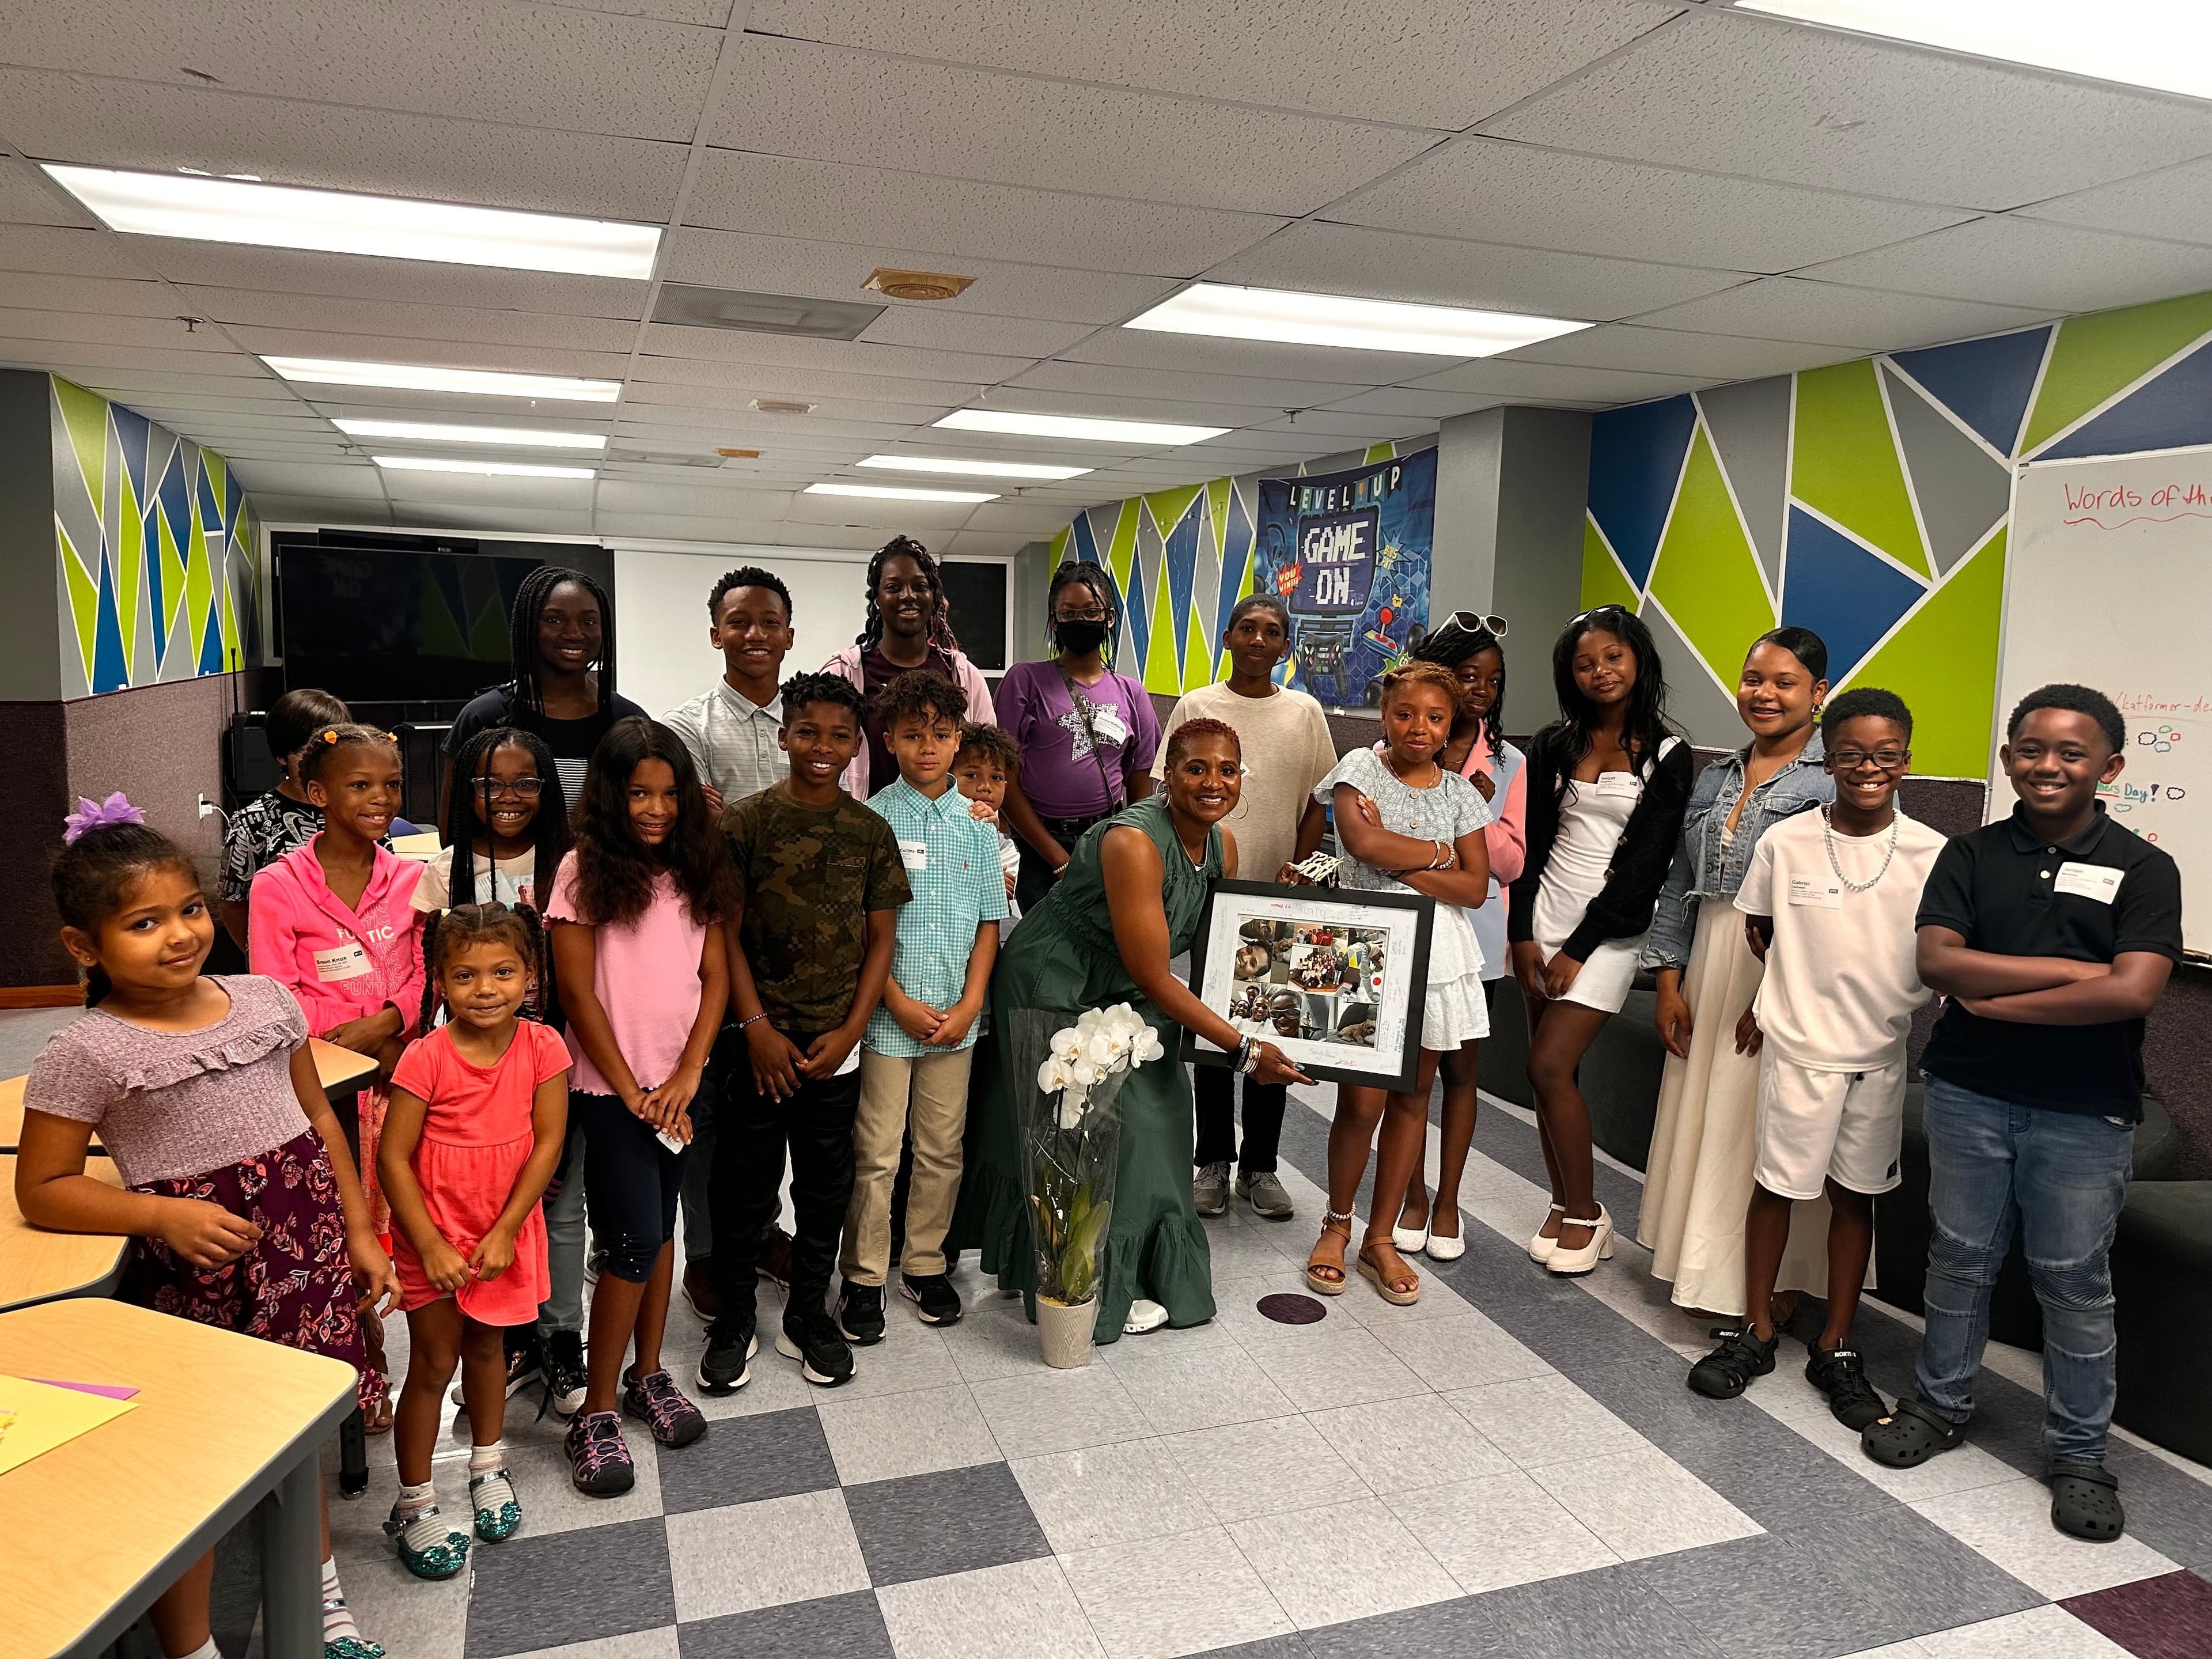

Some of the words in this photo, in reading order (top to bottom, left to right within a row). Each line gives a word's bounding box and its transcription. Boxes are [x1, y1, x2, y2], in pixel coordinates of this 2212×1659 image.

[1290, 486, 1350, 510] LEVEL
[1373, 466, 1400, 497] UP
[2065, 483, 2142, 511] Words
[2182, 484, 2212, 506] th
[1304, 521, 1369, 563] GAME
[1279, 567, 1296, 582] YOU
[1315, 567, 1350, 604] ON
